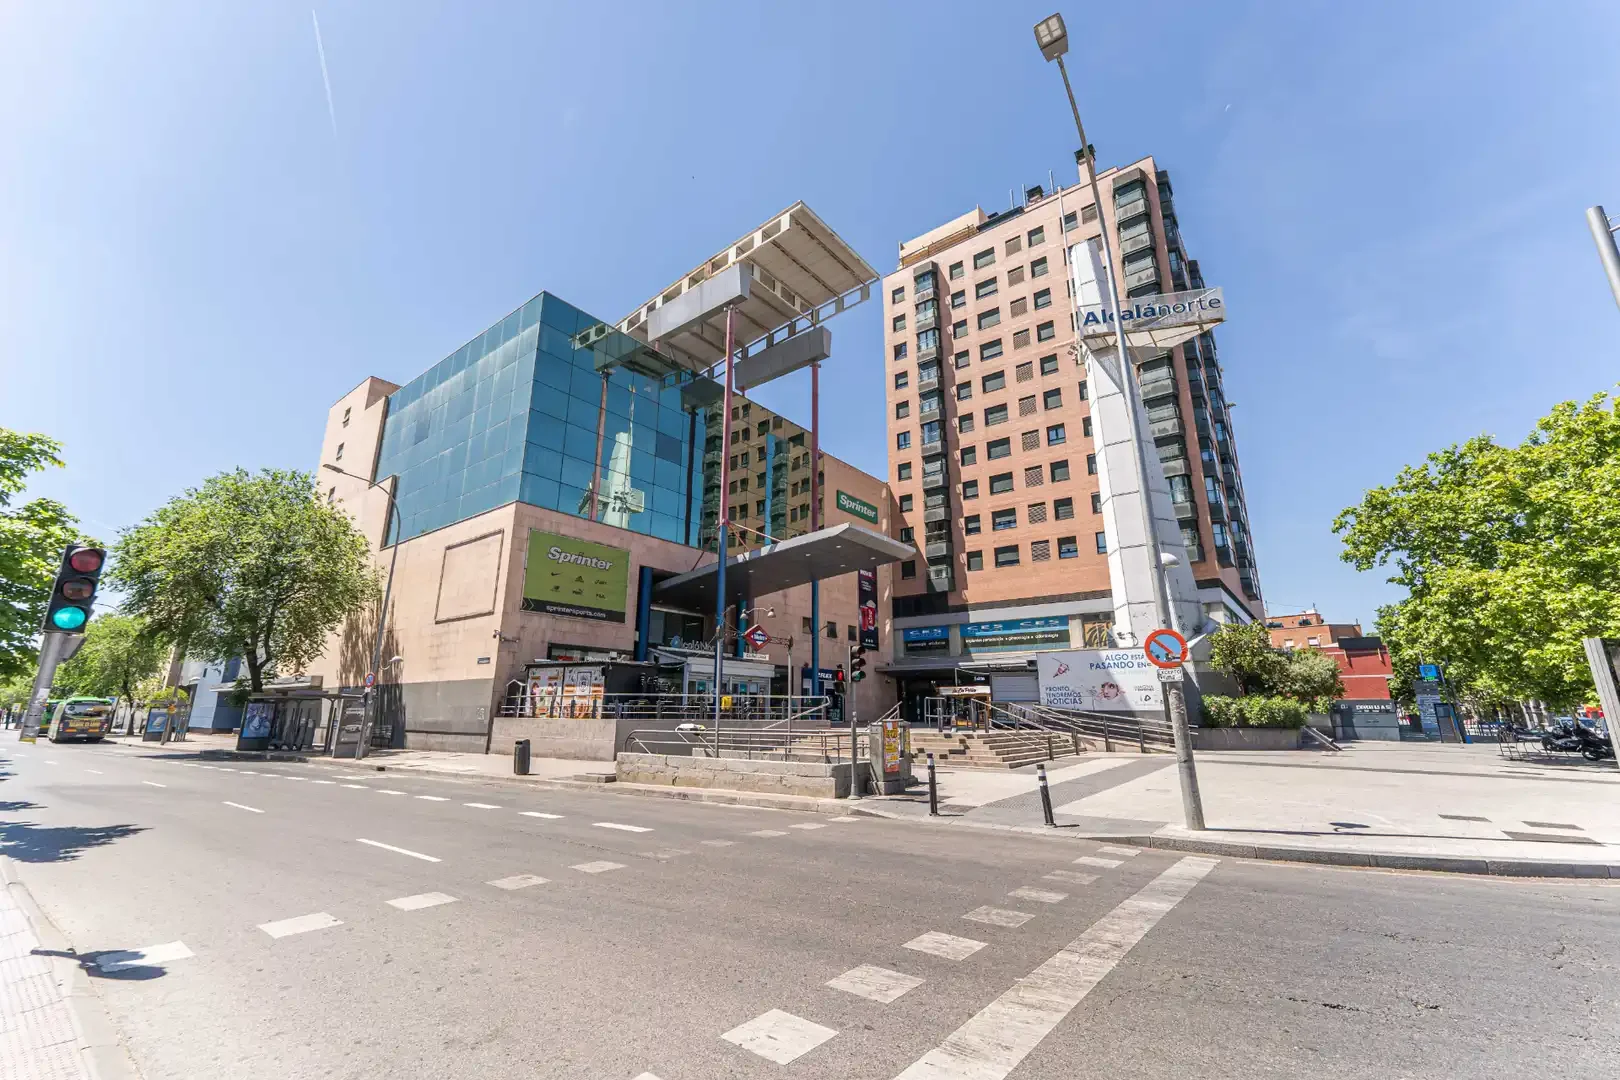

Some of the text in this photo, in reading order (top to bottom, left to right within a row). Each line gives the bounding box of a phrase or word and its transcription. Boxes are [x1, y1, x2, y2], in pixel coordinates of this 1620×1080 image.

[1083, 297, 1221, 326] Alcalánorte
[839, 494, 876, 518] Sprinter
[547, 546, 613, 571] Sprinter
[545, 604, 607, 619] sprintersports.com
[1089, 661, 1135, 670] PASANDO
[1105, 652, 1145, 662] ALGO ESTÁ
